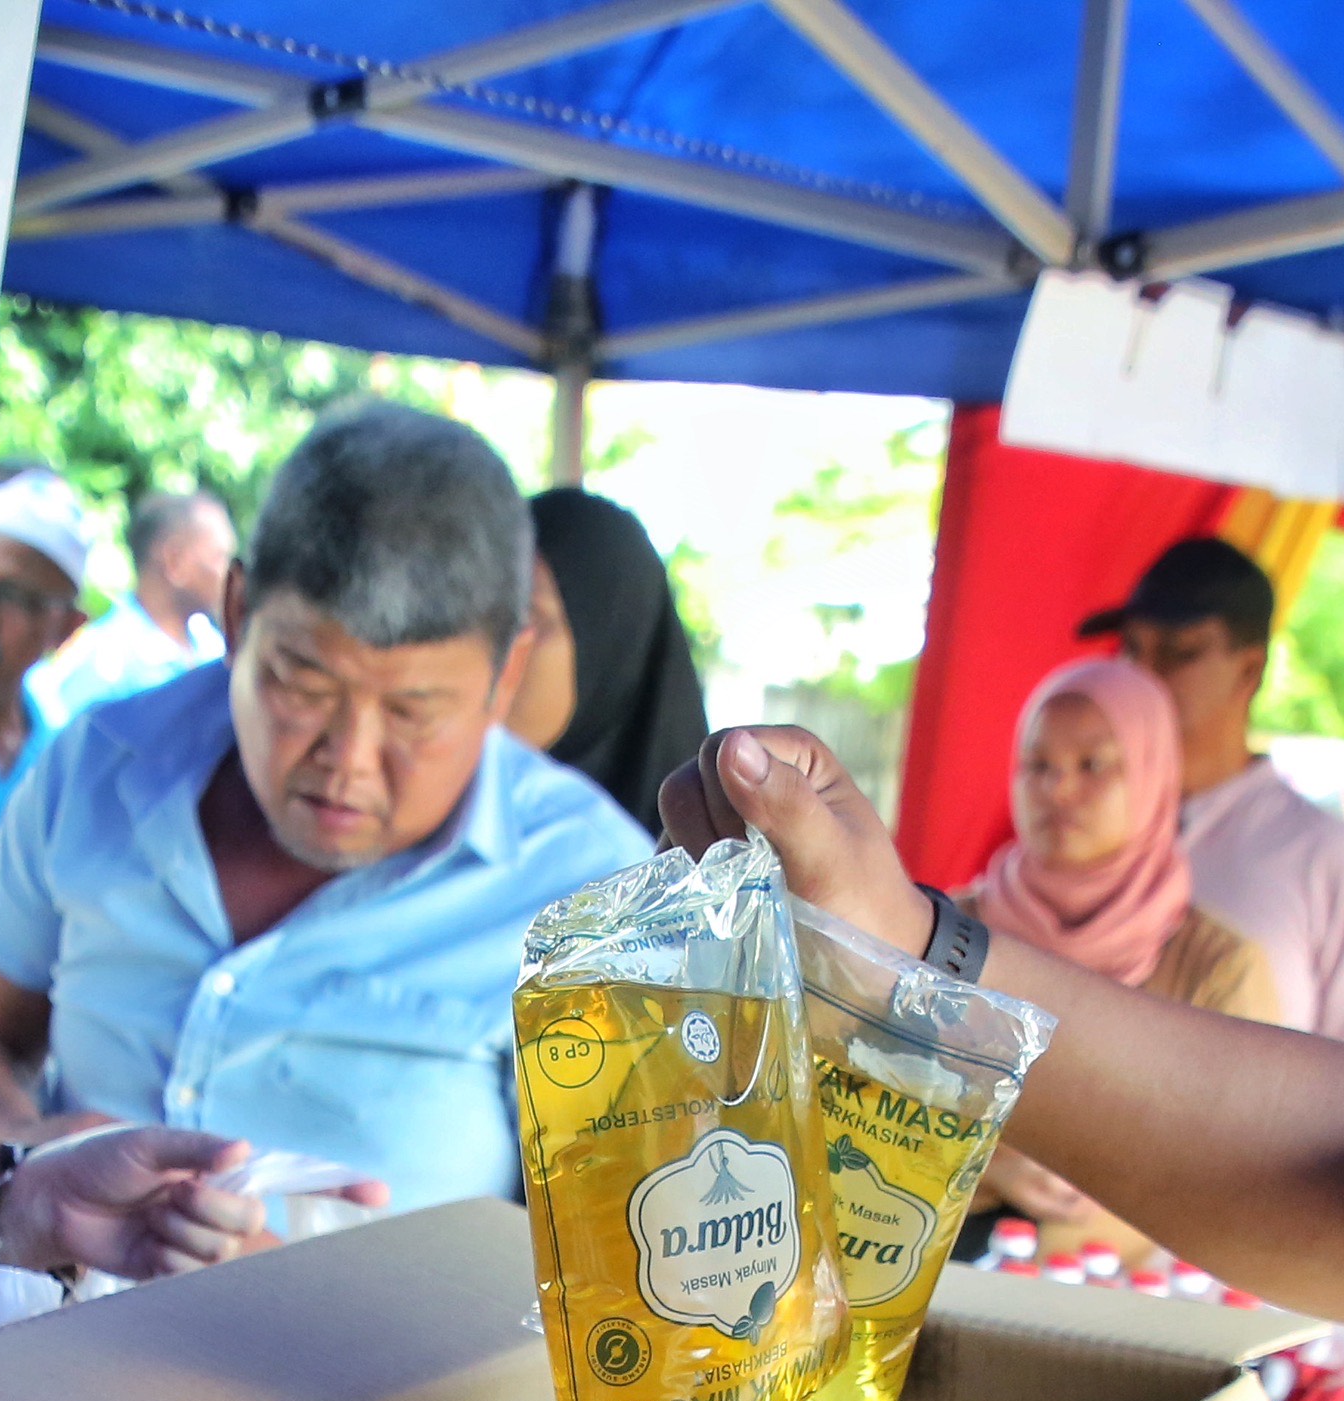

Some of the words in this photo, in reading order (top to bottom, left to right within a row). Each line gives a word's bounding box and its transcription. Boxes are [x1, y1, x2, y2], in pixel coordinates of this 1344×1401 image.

[548, 1045, 559, 1062] 8
[566, 1041, 590, 1059] CP
[585, 1100, 715, 1132] KOLESTEROL
[820, 1100, 925, 1154] ERKHASIAT
[660, 1200, 787, 1258] Bidara
[849, 1202, 902, 1227] Masak
[837, 1230, 904, 1265] ara
[681, 1267, 732, 1295] Masak
[735, 1257, 777, 1284] Minyak
[693, 1341, 788, 1387] BERKHASIAT
